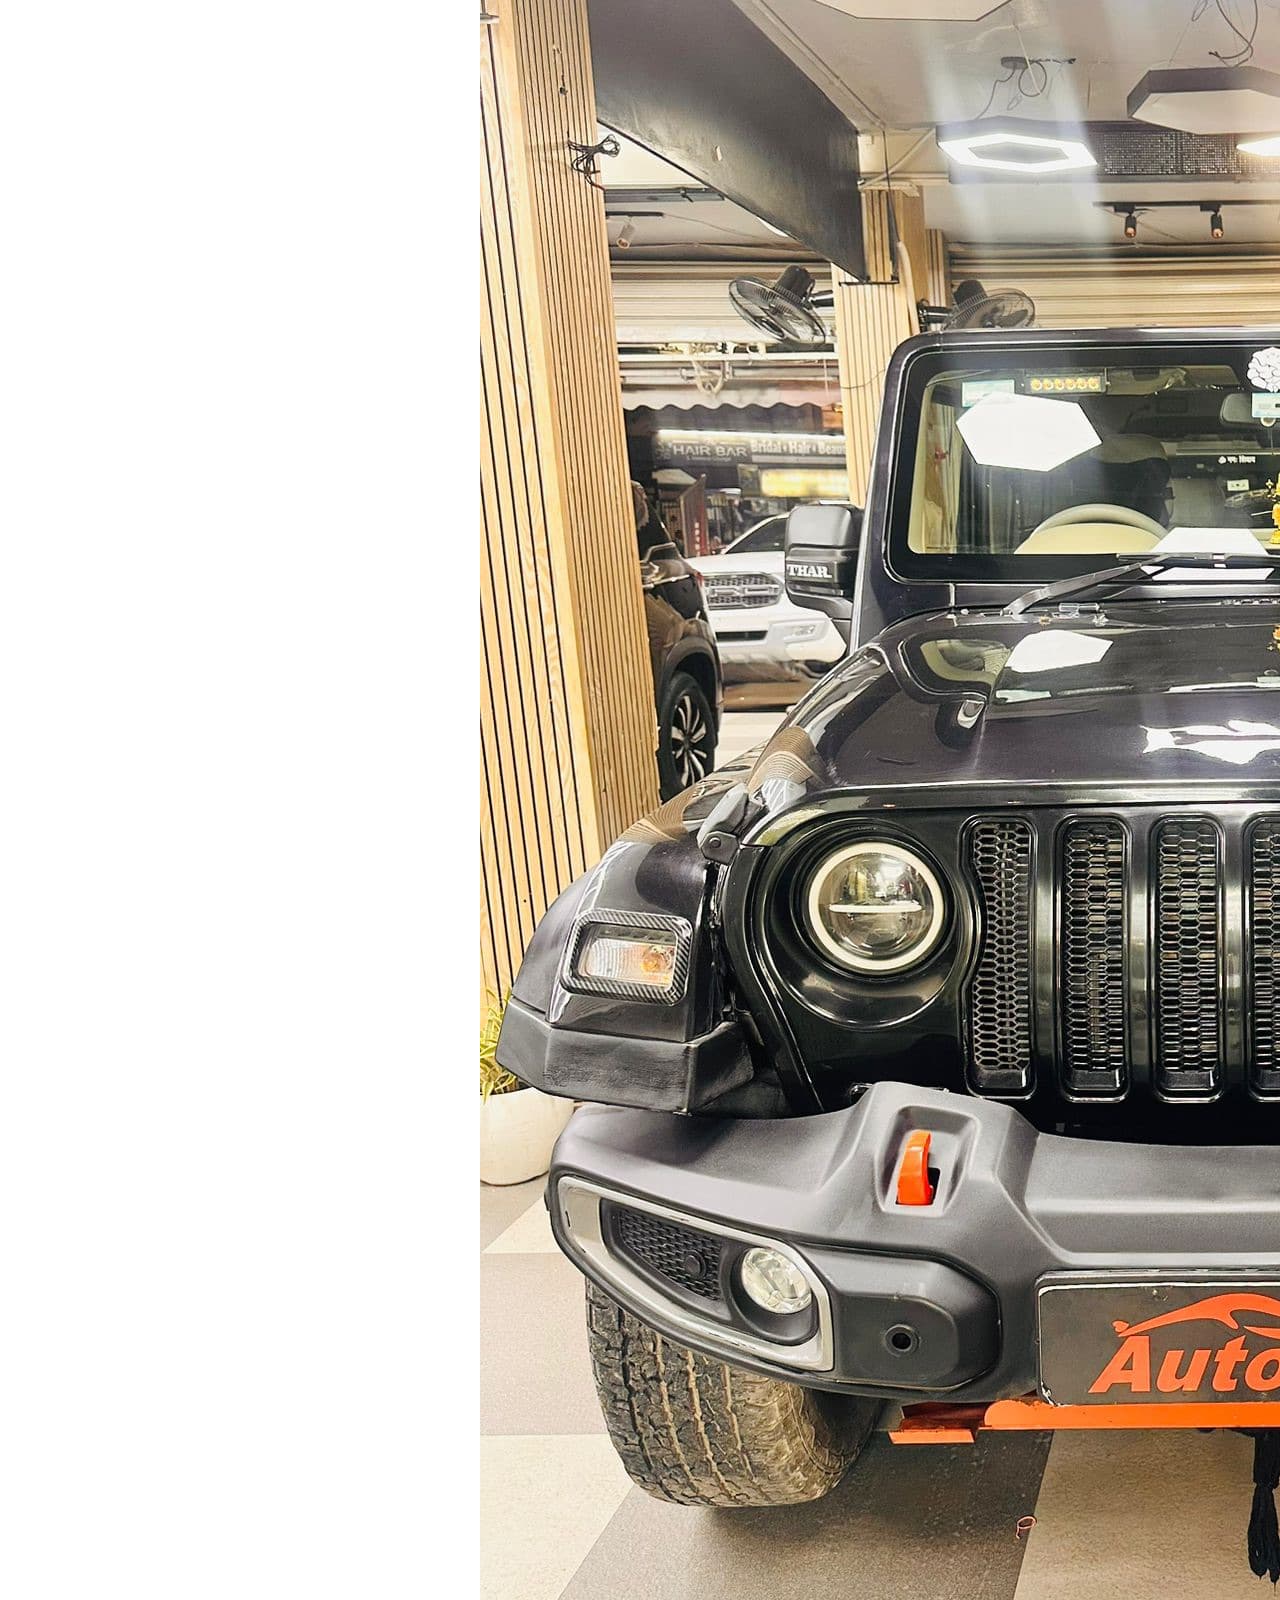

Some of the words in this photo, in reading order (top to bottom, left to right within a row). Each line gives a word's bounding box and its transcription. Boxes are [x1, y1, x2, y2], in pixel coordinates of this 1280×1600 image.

[672, 445, 711, 456] HAIR
[716, 446, 748, 458] BAR
[787, 563, 832, 579] THAR
